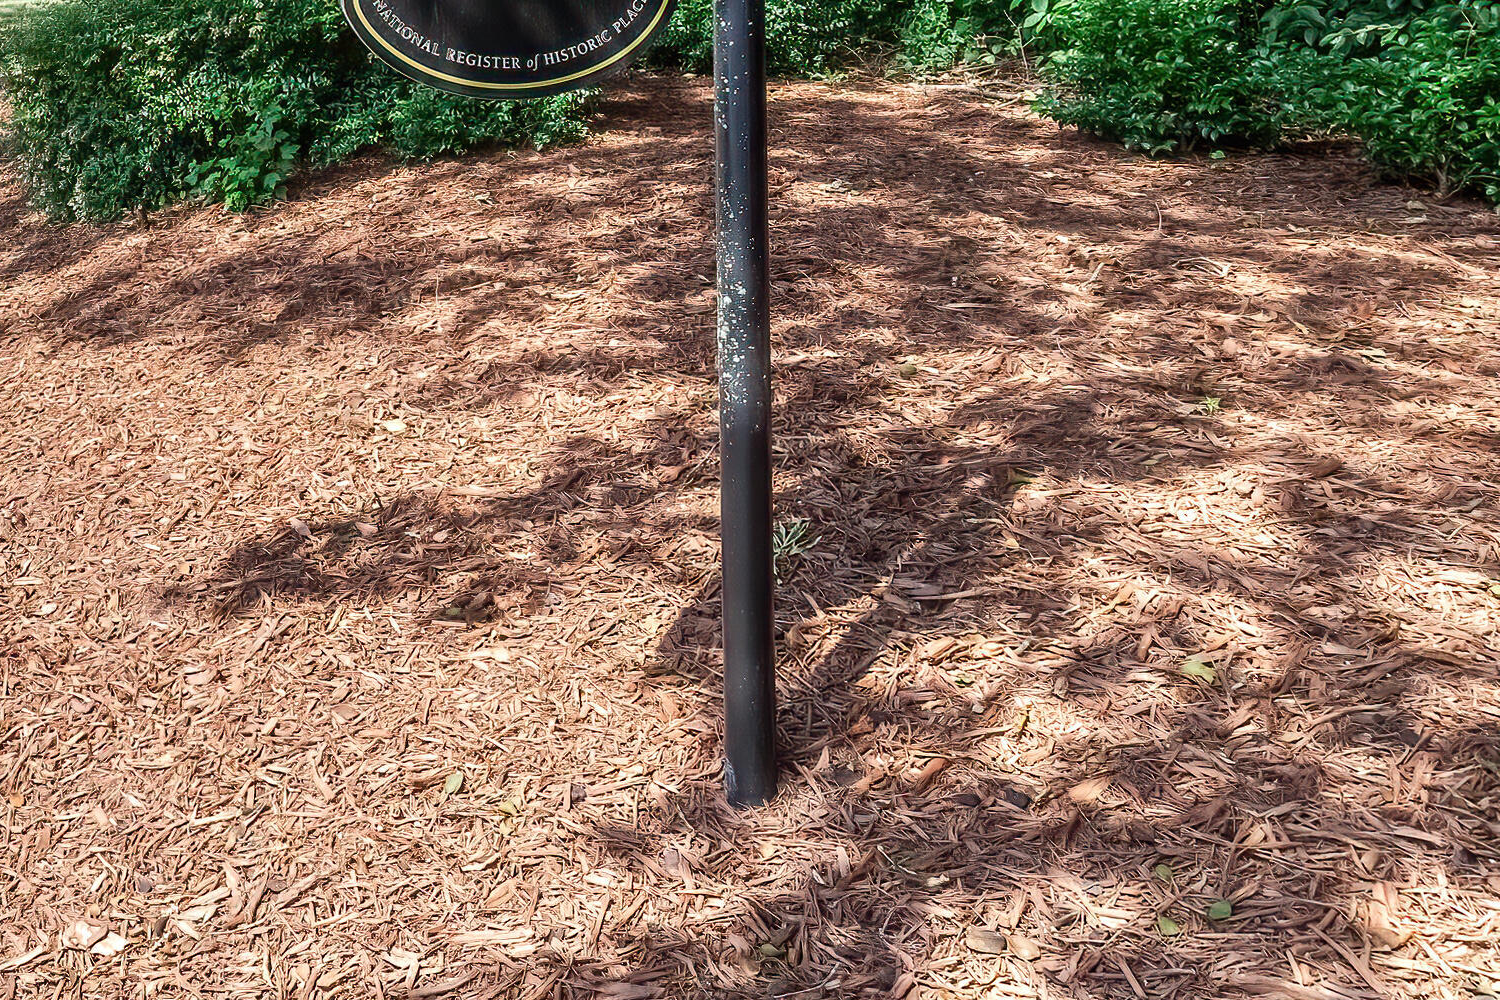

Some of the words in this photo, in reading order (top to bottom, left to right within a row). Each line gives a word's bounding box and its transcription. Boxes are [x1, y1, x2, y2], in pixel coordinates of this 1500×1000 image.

[446, 47, 521, 70] REGISTER
[526, 53, 540, 72] of
[544, 29, 613, 66] HISTORIC
